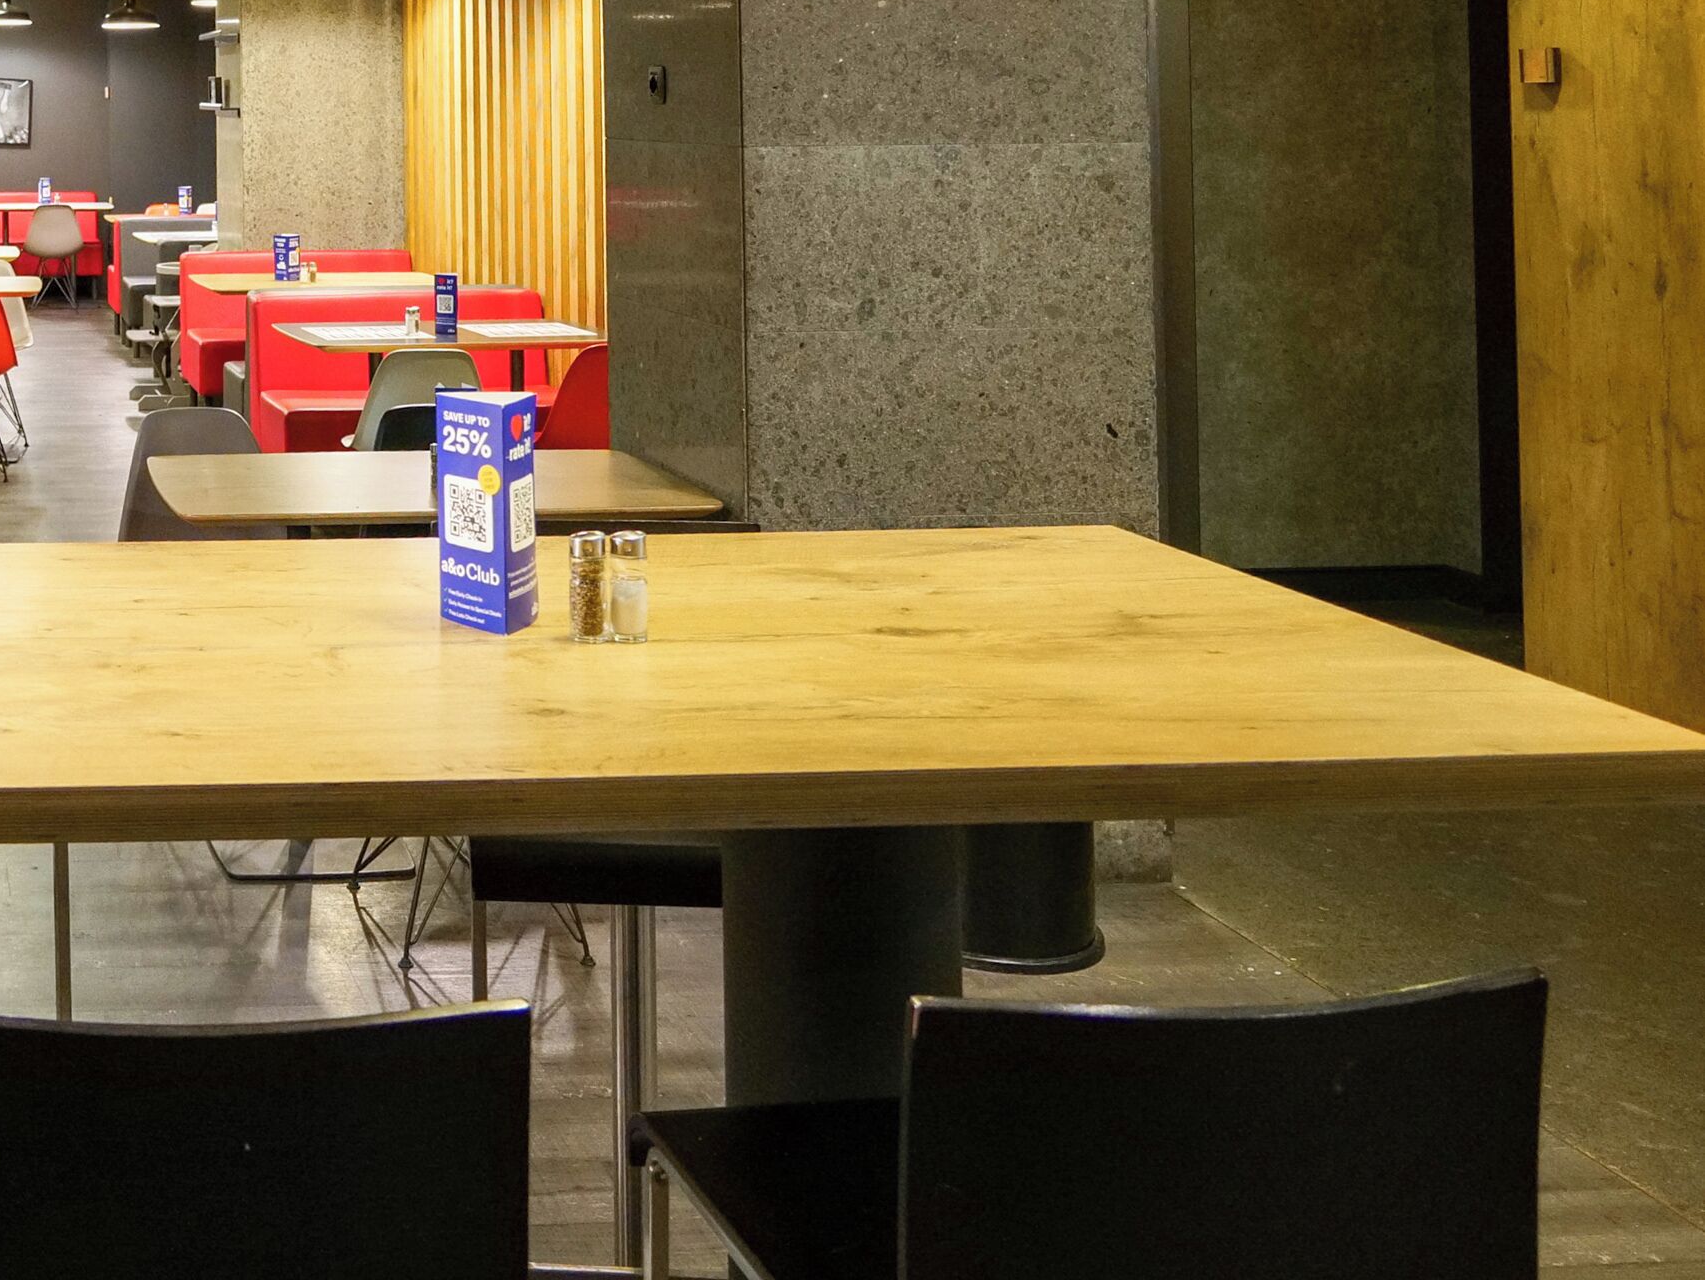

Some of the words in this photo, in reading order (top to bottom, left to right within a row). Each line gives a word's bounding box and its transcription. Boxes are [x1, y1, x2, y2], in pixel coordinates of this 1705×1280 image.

[443, 410, 464, 424] SAVE
[464, 413, 476, 426] UP
[477, 415, 490, 428] TO
[442, 424, 492, 459] 25%
[441, 557, 466, 578] a&o
[466, 563, 500, 587] Club
